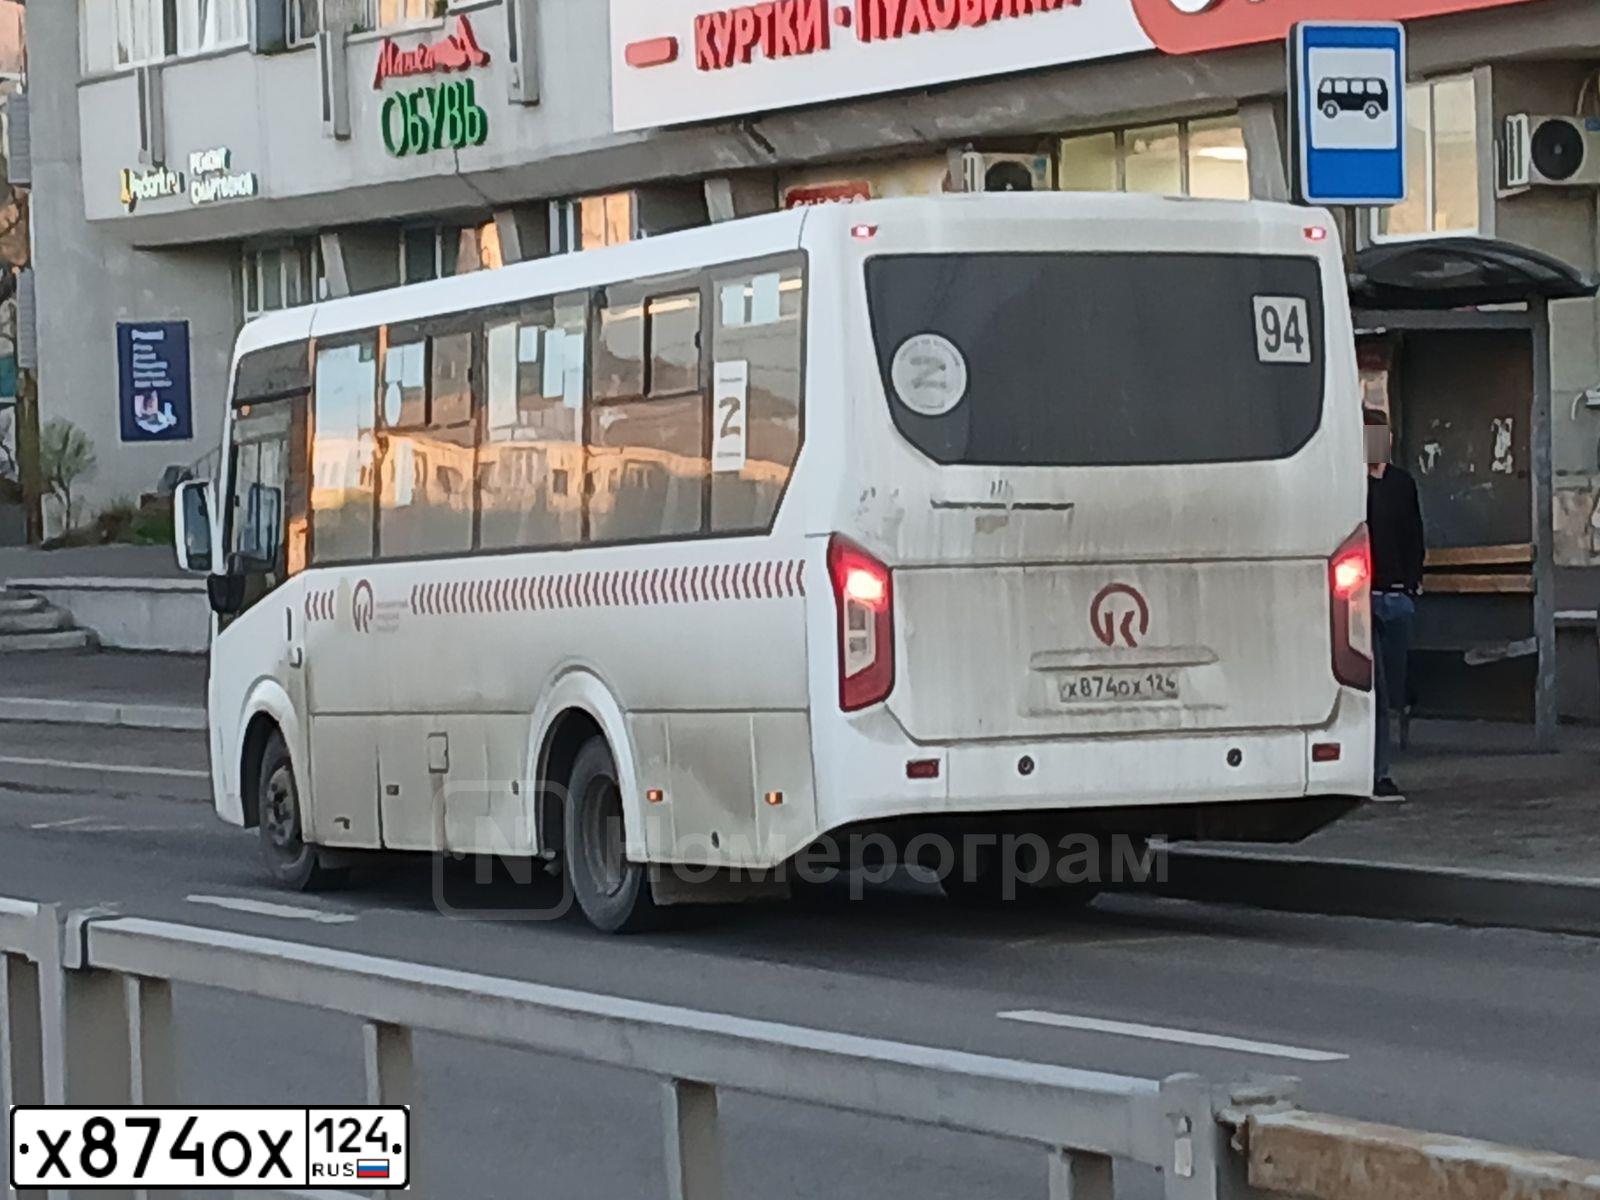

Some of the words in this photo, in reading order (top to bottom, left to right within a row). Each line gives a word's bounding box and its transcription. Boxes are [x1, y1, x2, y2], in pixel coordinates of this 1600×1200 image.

[694, 0, 831, 71] КУРТКИ
[856, 0, 1082, 42] ПУХО
[381, 78, 488, 157] ОБУВЬ
[1261, 305, 1304, 354] 94
[718, 396, 741, 439] 2
